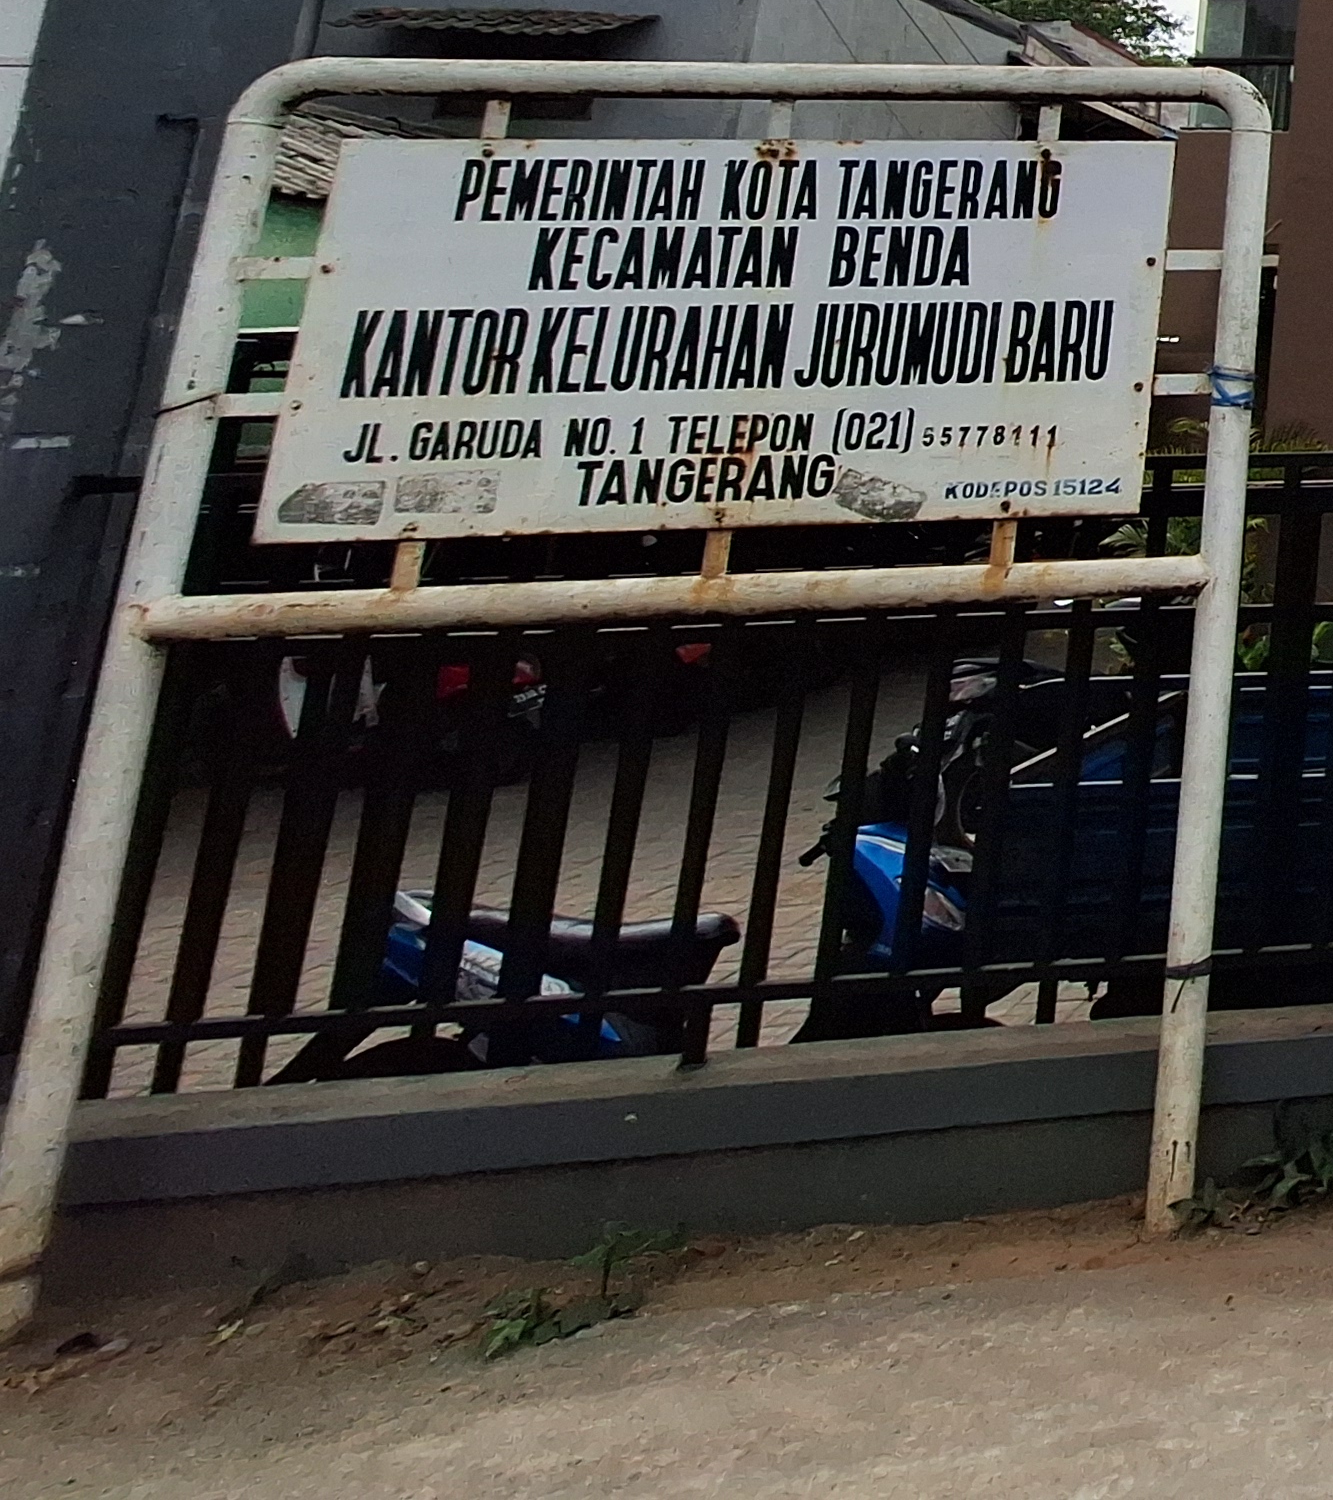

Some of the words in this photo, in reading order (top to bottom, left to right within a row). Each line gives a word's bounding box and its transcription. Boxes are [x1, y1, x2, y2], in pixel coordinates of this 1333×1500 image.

[455, 159, 705, 221] PEMERINTAH
[720, 159, 816, 220] KOTA
[838, 159, 1062, 219] TANGERANG
[528, 226, 799, 290] KECAMATAN
[829, 226, 969, 287] BENDA
[340, 308, 528, 398] KANTOR
[528, 304, 793, 393] KELURAHAN
[794, 302, 1002, 388] JURUMUDI
[1003, 300, 1114, 383] BARU
[343, 423, 398, 463] JL.
[409, 420, 541, 460] GARUDA
[564, 418, 615, 456] NO.
[629, 417, 644, 454] 1
[669, 414, 814, 455] TELEPON
[832, 408, 914, 455] (021)
[577, 454, 835, 506] TANGERANG
[1054, 478, 1120, 495] 15124
